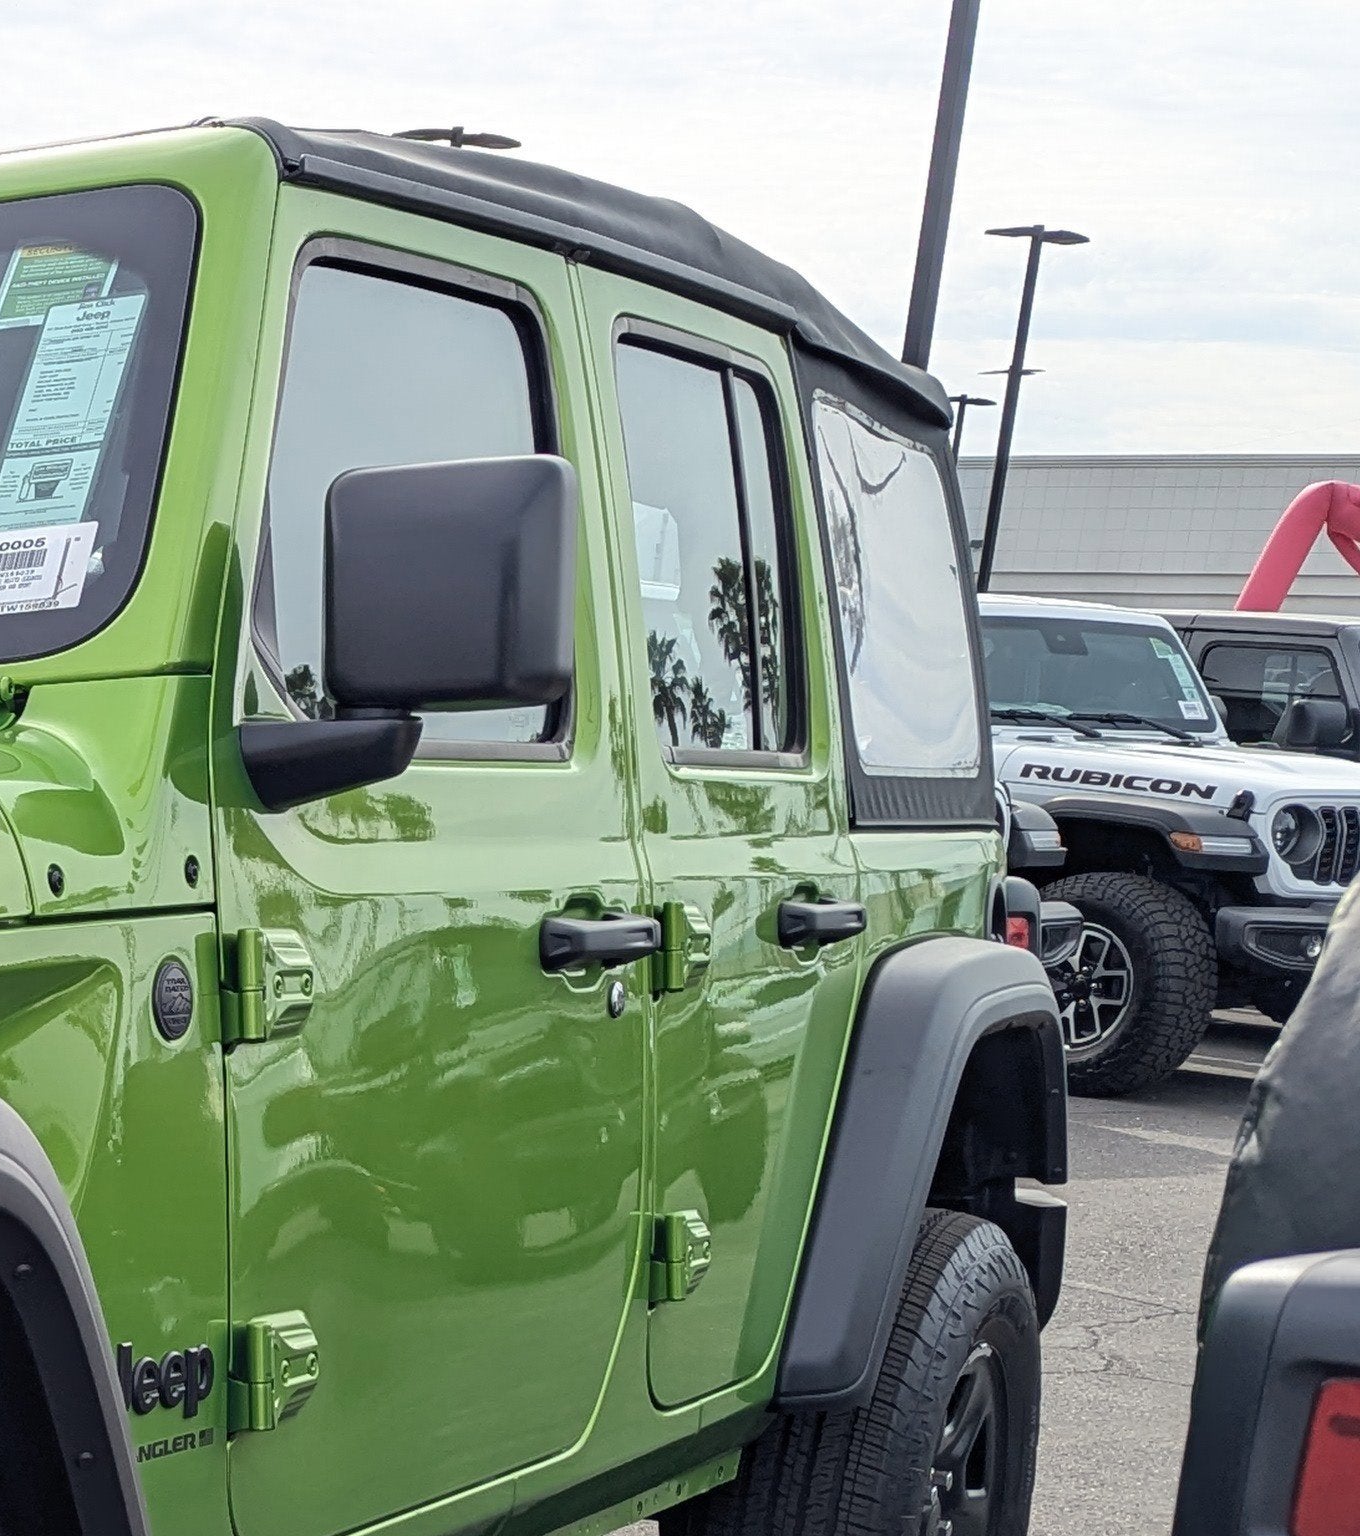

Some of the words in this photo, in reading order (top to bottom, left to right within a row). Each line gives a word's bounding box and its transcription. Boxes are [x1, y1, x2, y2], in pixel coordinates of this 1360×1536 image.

[76, 310, 111, 322] Jeep
[9, 440, 44, 450] TOTAL
[1019, 763, 1218, 800] RUBICON
[136, 1432, 197, 1463] NGLER
